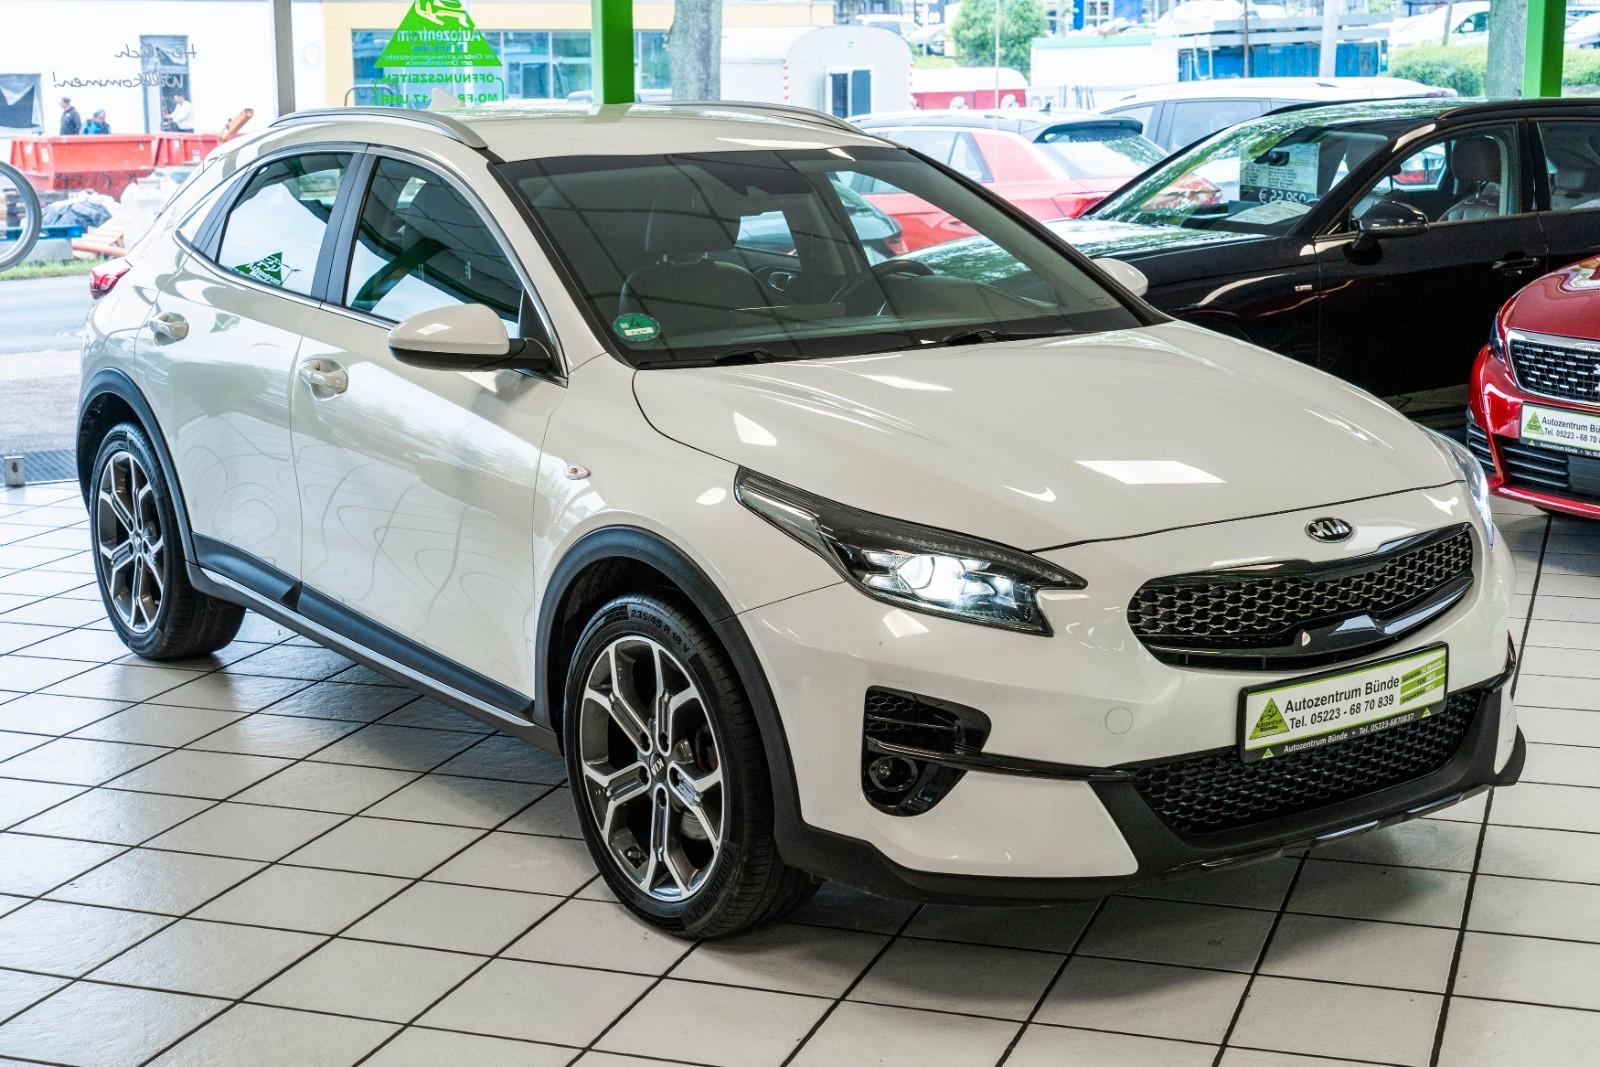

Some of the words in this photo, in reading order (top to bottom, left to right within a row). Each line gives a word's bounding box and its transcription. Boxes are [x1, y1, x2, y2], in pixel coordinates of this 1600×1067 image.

[1542, 416, 1588, 431] Autozentrum
[1311, 520, 1350, 537] KIA
[1284, 685, 1361, 714] Autozentrum
[1365, 676, 1400, 696] Bünde
[1289, 714, 1307, 730] Tel.
[1310, 707, 1341, 726] 05223
[1350, 703, 1361, 716] 68
[1364, 699, 1375, 713] 70
[1377, 694, 1394, 709] 839
[1284, 738, 1327, 753] Autozentrum
[1328, 732, 1348, 743] Bünde
